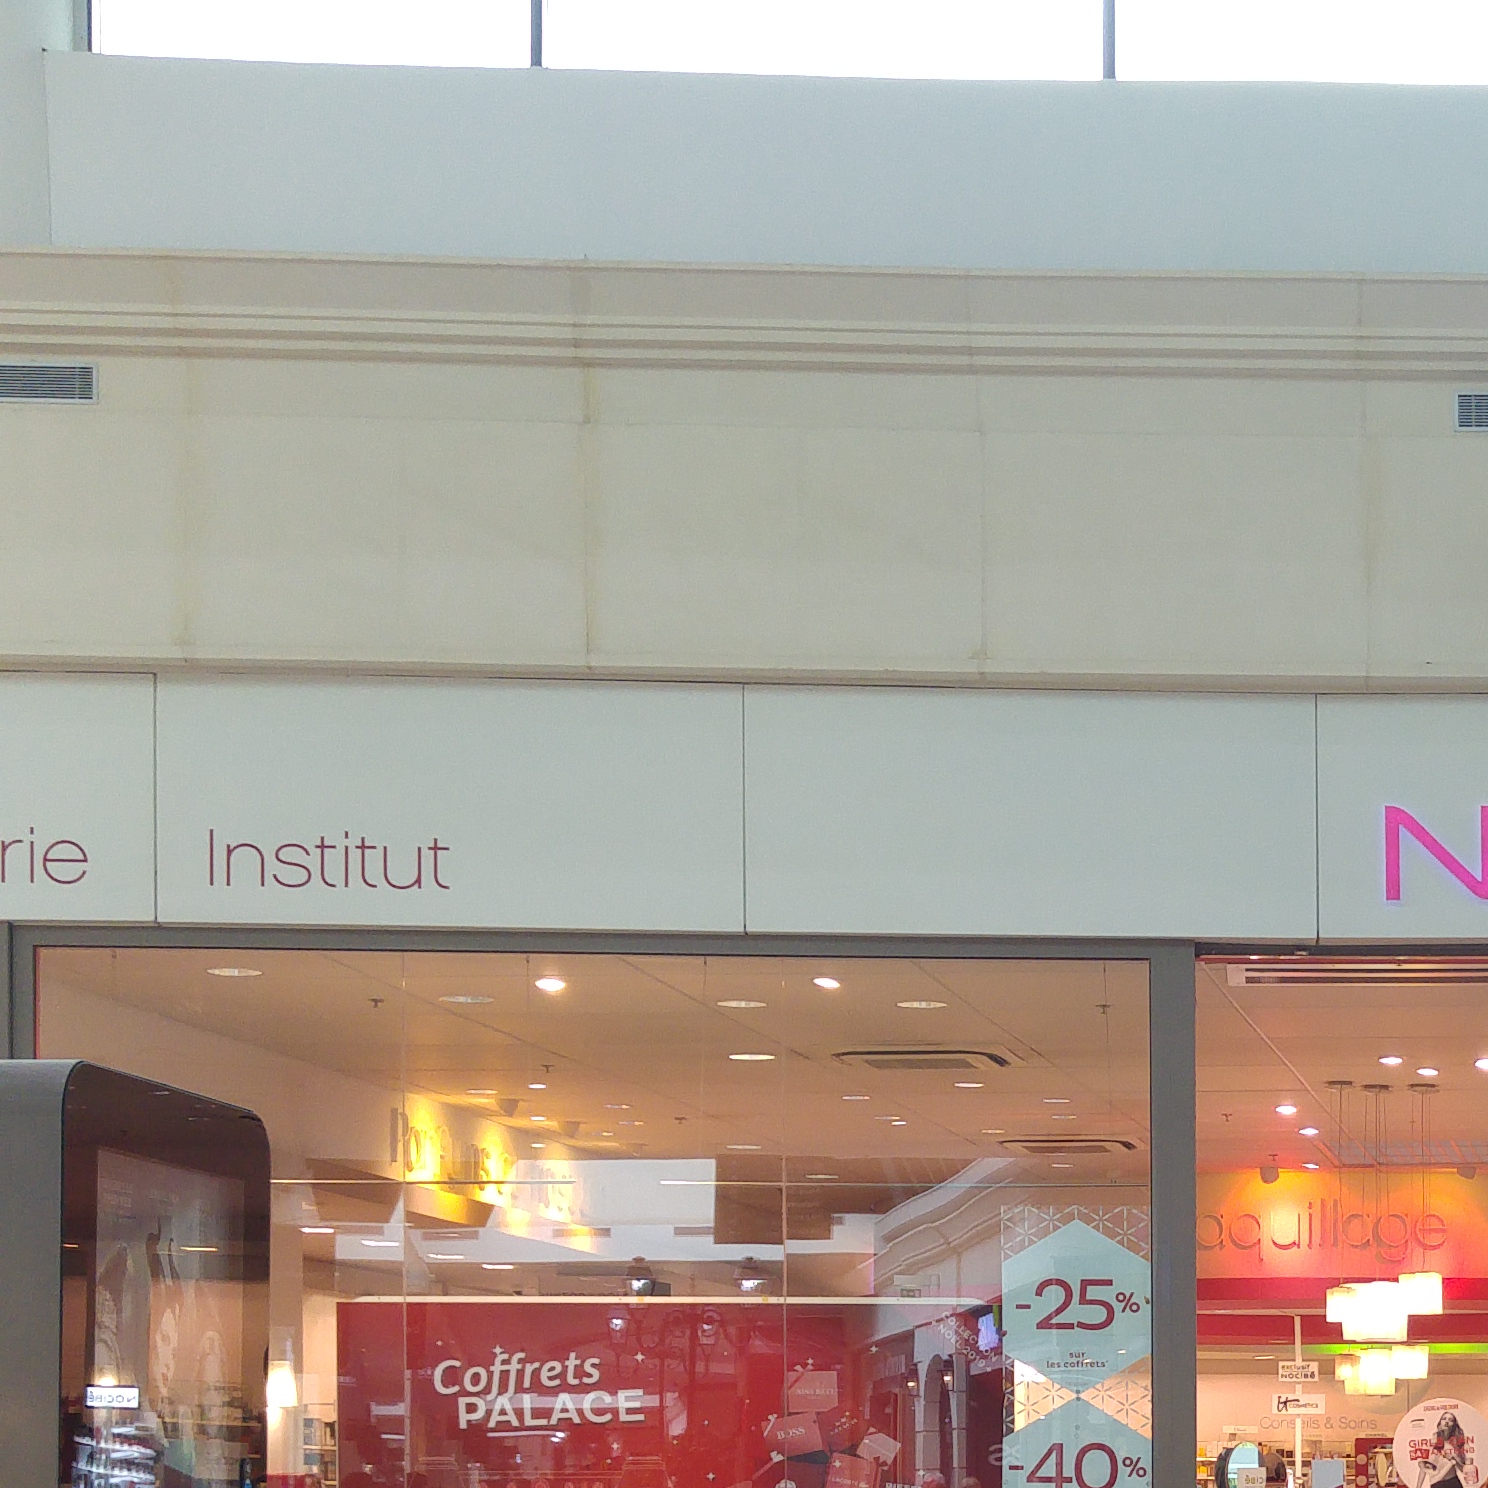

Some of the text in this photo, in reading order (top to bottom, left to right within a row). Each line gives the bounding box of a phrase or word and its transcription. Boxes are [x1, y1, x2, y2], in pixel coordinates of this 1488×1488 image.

[1, 826, 451, 890] rie Institut
[1015, 1278, 1140, 1331] -25%
[942, 1312, 998, 1362] COLLECON
[434, 1352, 601, 1400] Coffrets
[1046, 1360, 1061, 1368] les
[458, 1389, 645, 1430] PALACE
[1324, 1417, 1334, 1430] &
[1338, 1416, 1378, 1430] Soins
